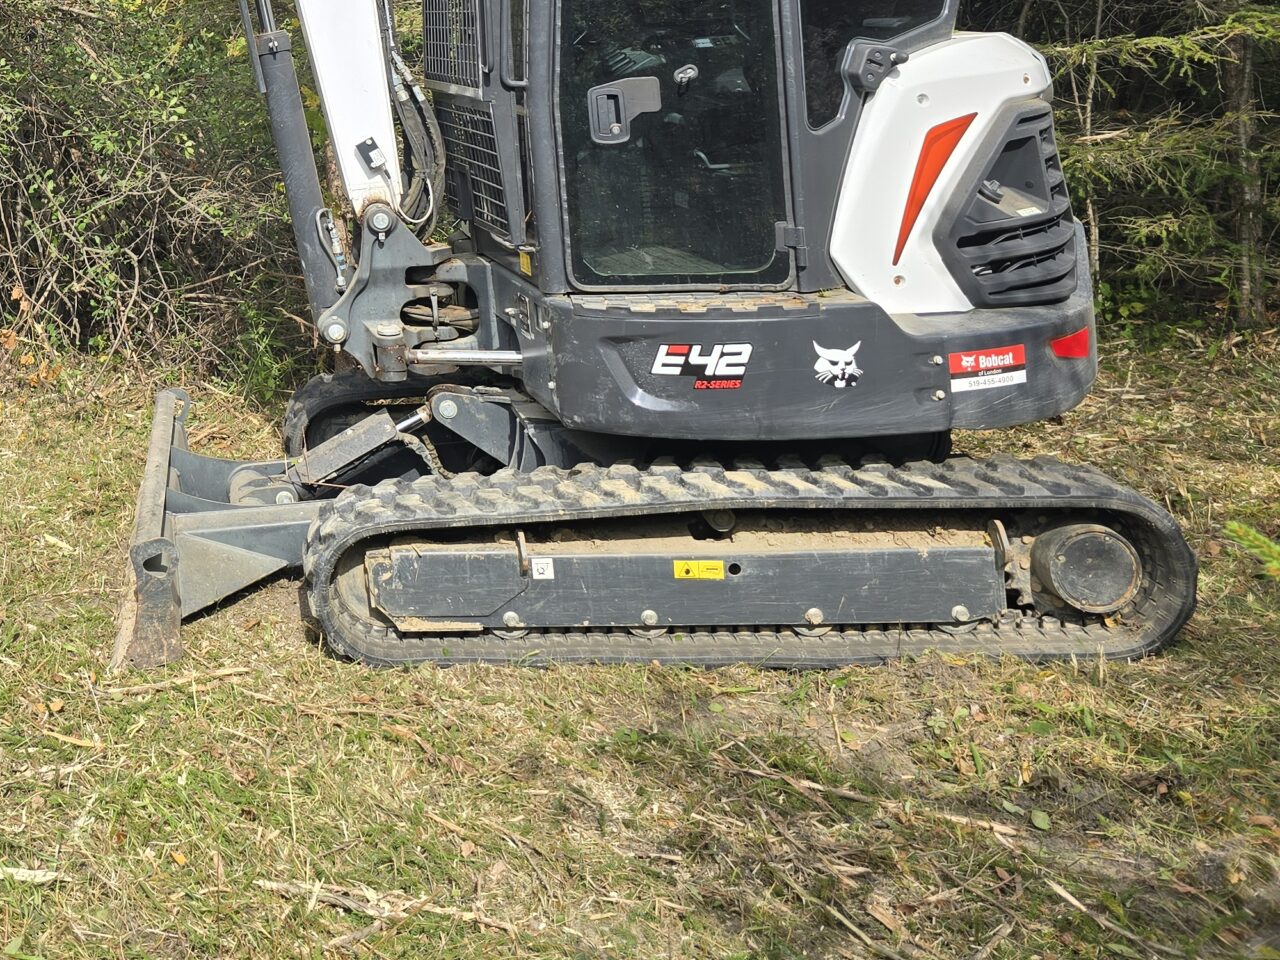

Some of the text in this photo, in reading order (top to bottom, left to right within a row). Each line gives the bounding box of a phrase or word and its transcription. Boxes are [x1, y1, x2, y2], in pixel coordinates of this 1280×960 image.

[651, 344, 753, 376] E42
[978, 352, 1014, 368] Bobcat
[694, 380, 741, 389] R2-SERIES
[968, 375, 1014, 388] 519-455-4900
